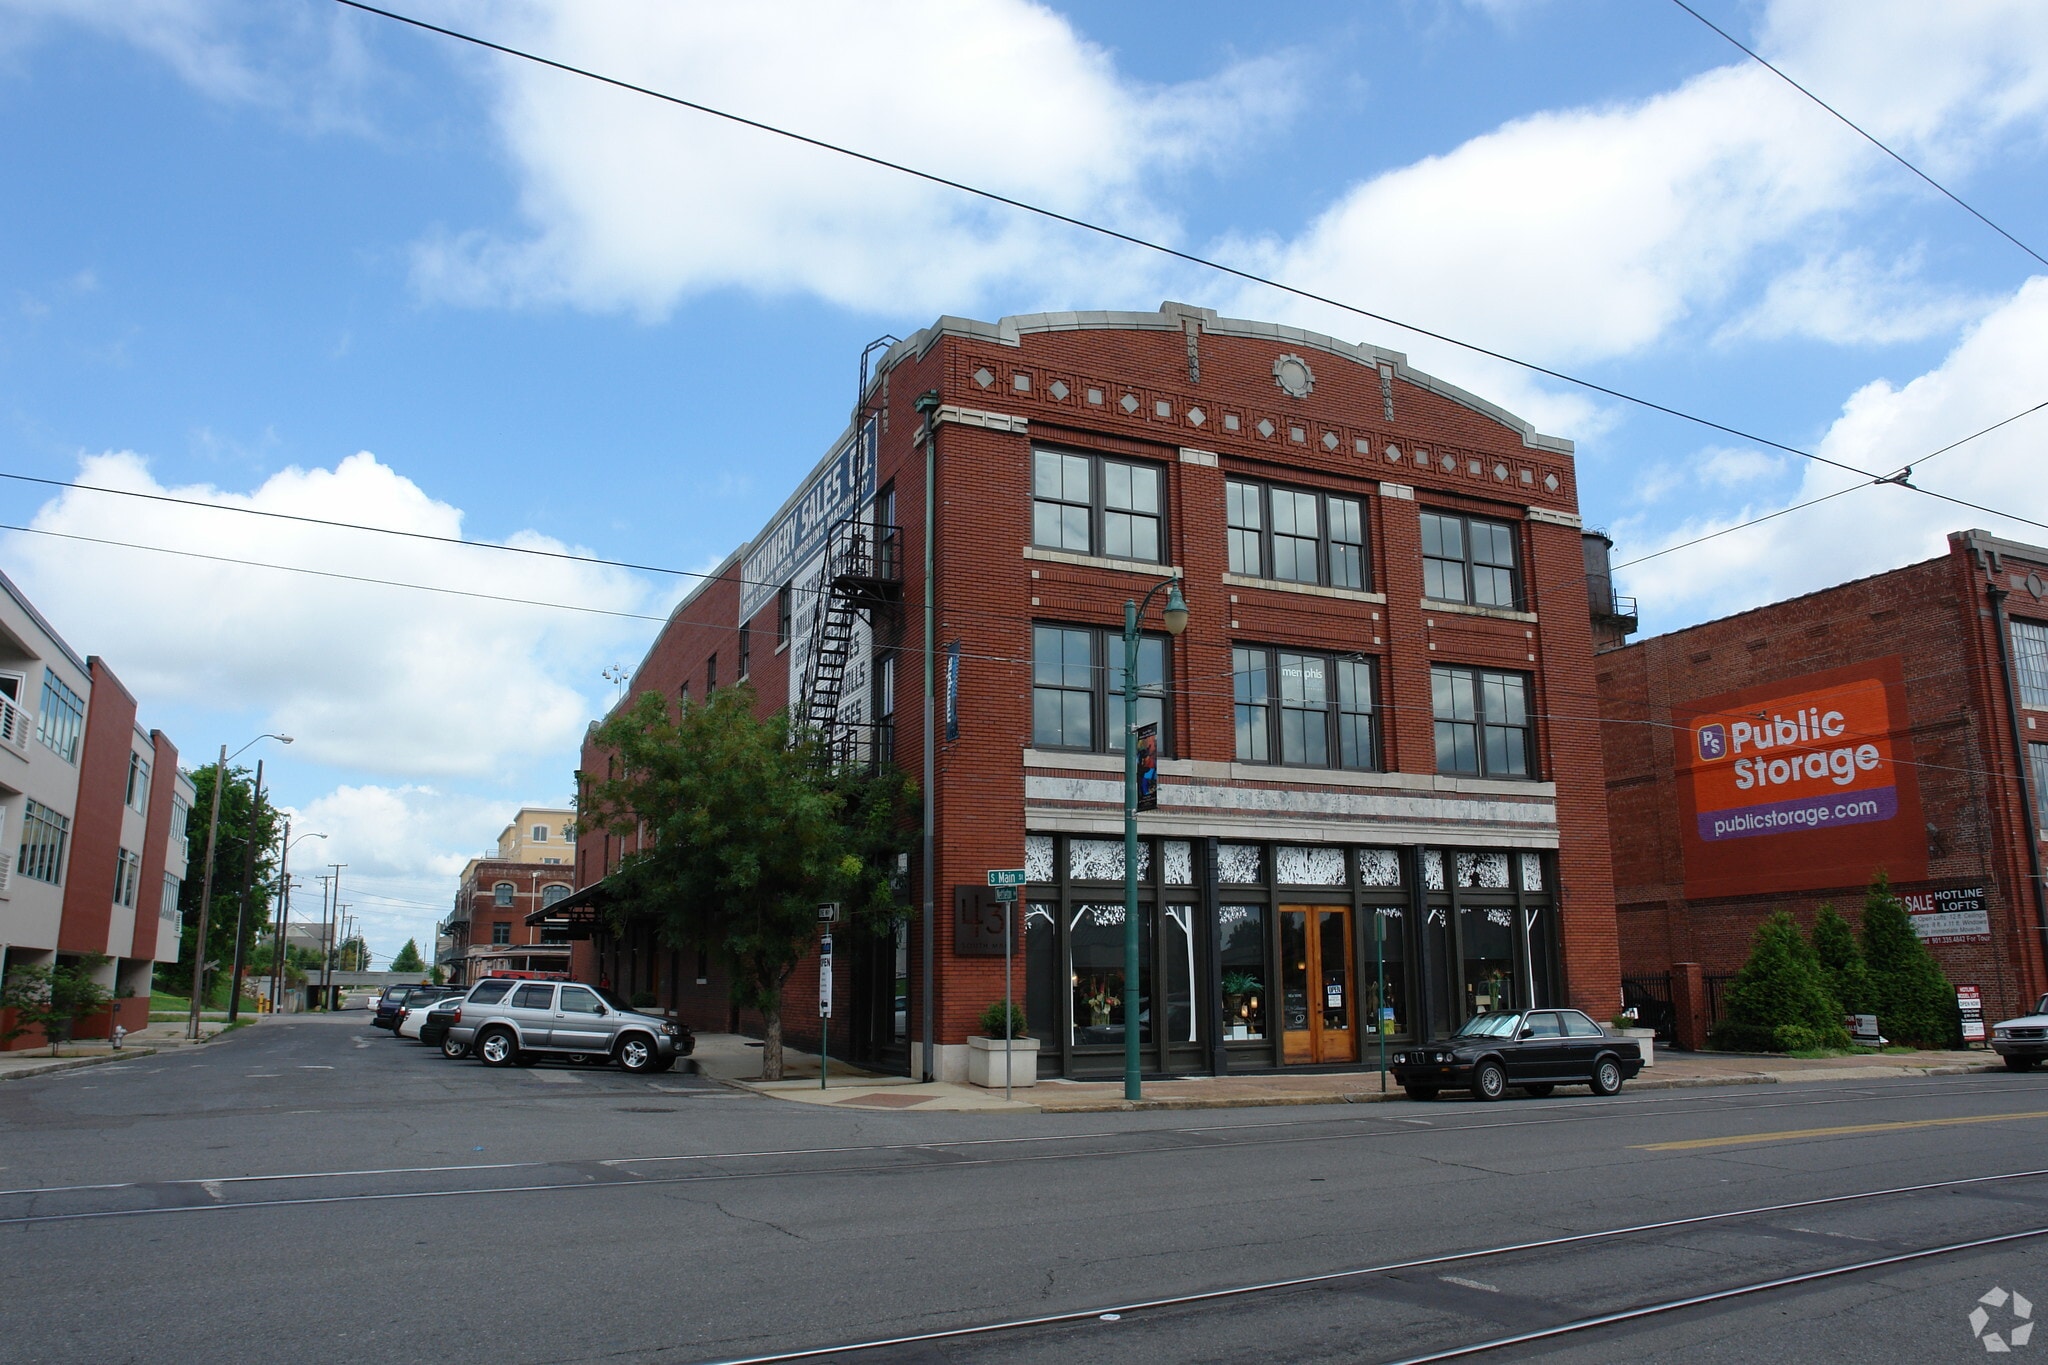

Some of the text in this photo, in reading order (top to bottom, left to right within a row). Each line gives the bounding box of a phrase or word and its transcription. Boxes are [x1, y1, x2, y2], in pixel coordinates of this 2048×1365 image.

[743, 511, 799, 599] MACHINERY
[801, 463, 842, 538] SALES
[775, 558, 793, 582] METAL
[795, 522, 825, 562] WORKING
[1282, 667, 1323, 680] memphis
[1731, 707, 1846, 754] Public
[1734, 743, 1880, 790] Storage
[1714, 800, 1878, 837] publicstorage.com
[990, 873, 995, 883] S
[998, 871, 1016, 884] Main
[1905, 894, 1934, 912] SALE
[1934, 888, 1984, 900] HOTLINE
[1942, 900, 1979, 911] LOFTS
[1918, 915, 1932, 923] Open
[1963, 911, 1986, 920] Ceilings
[1962, 918, 1987, 926] Windows
